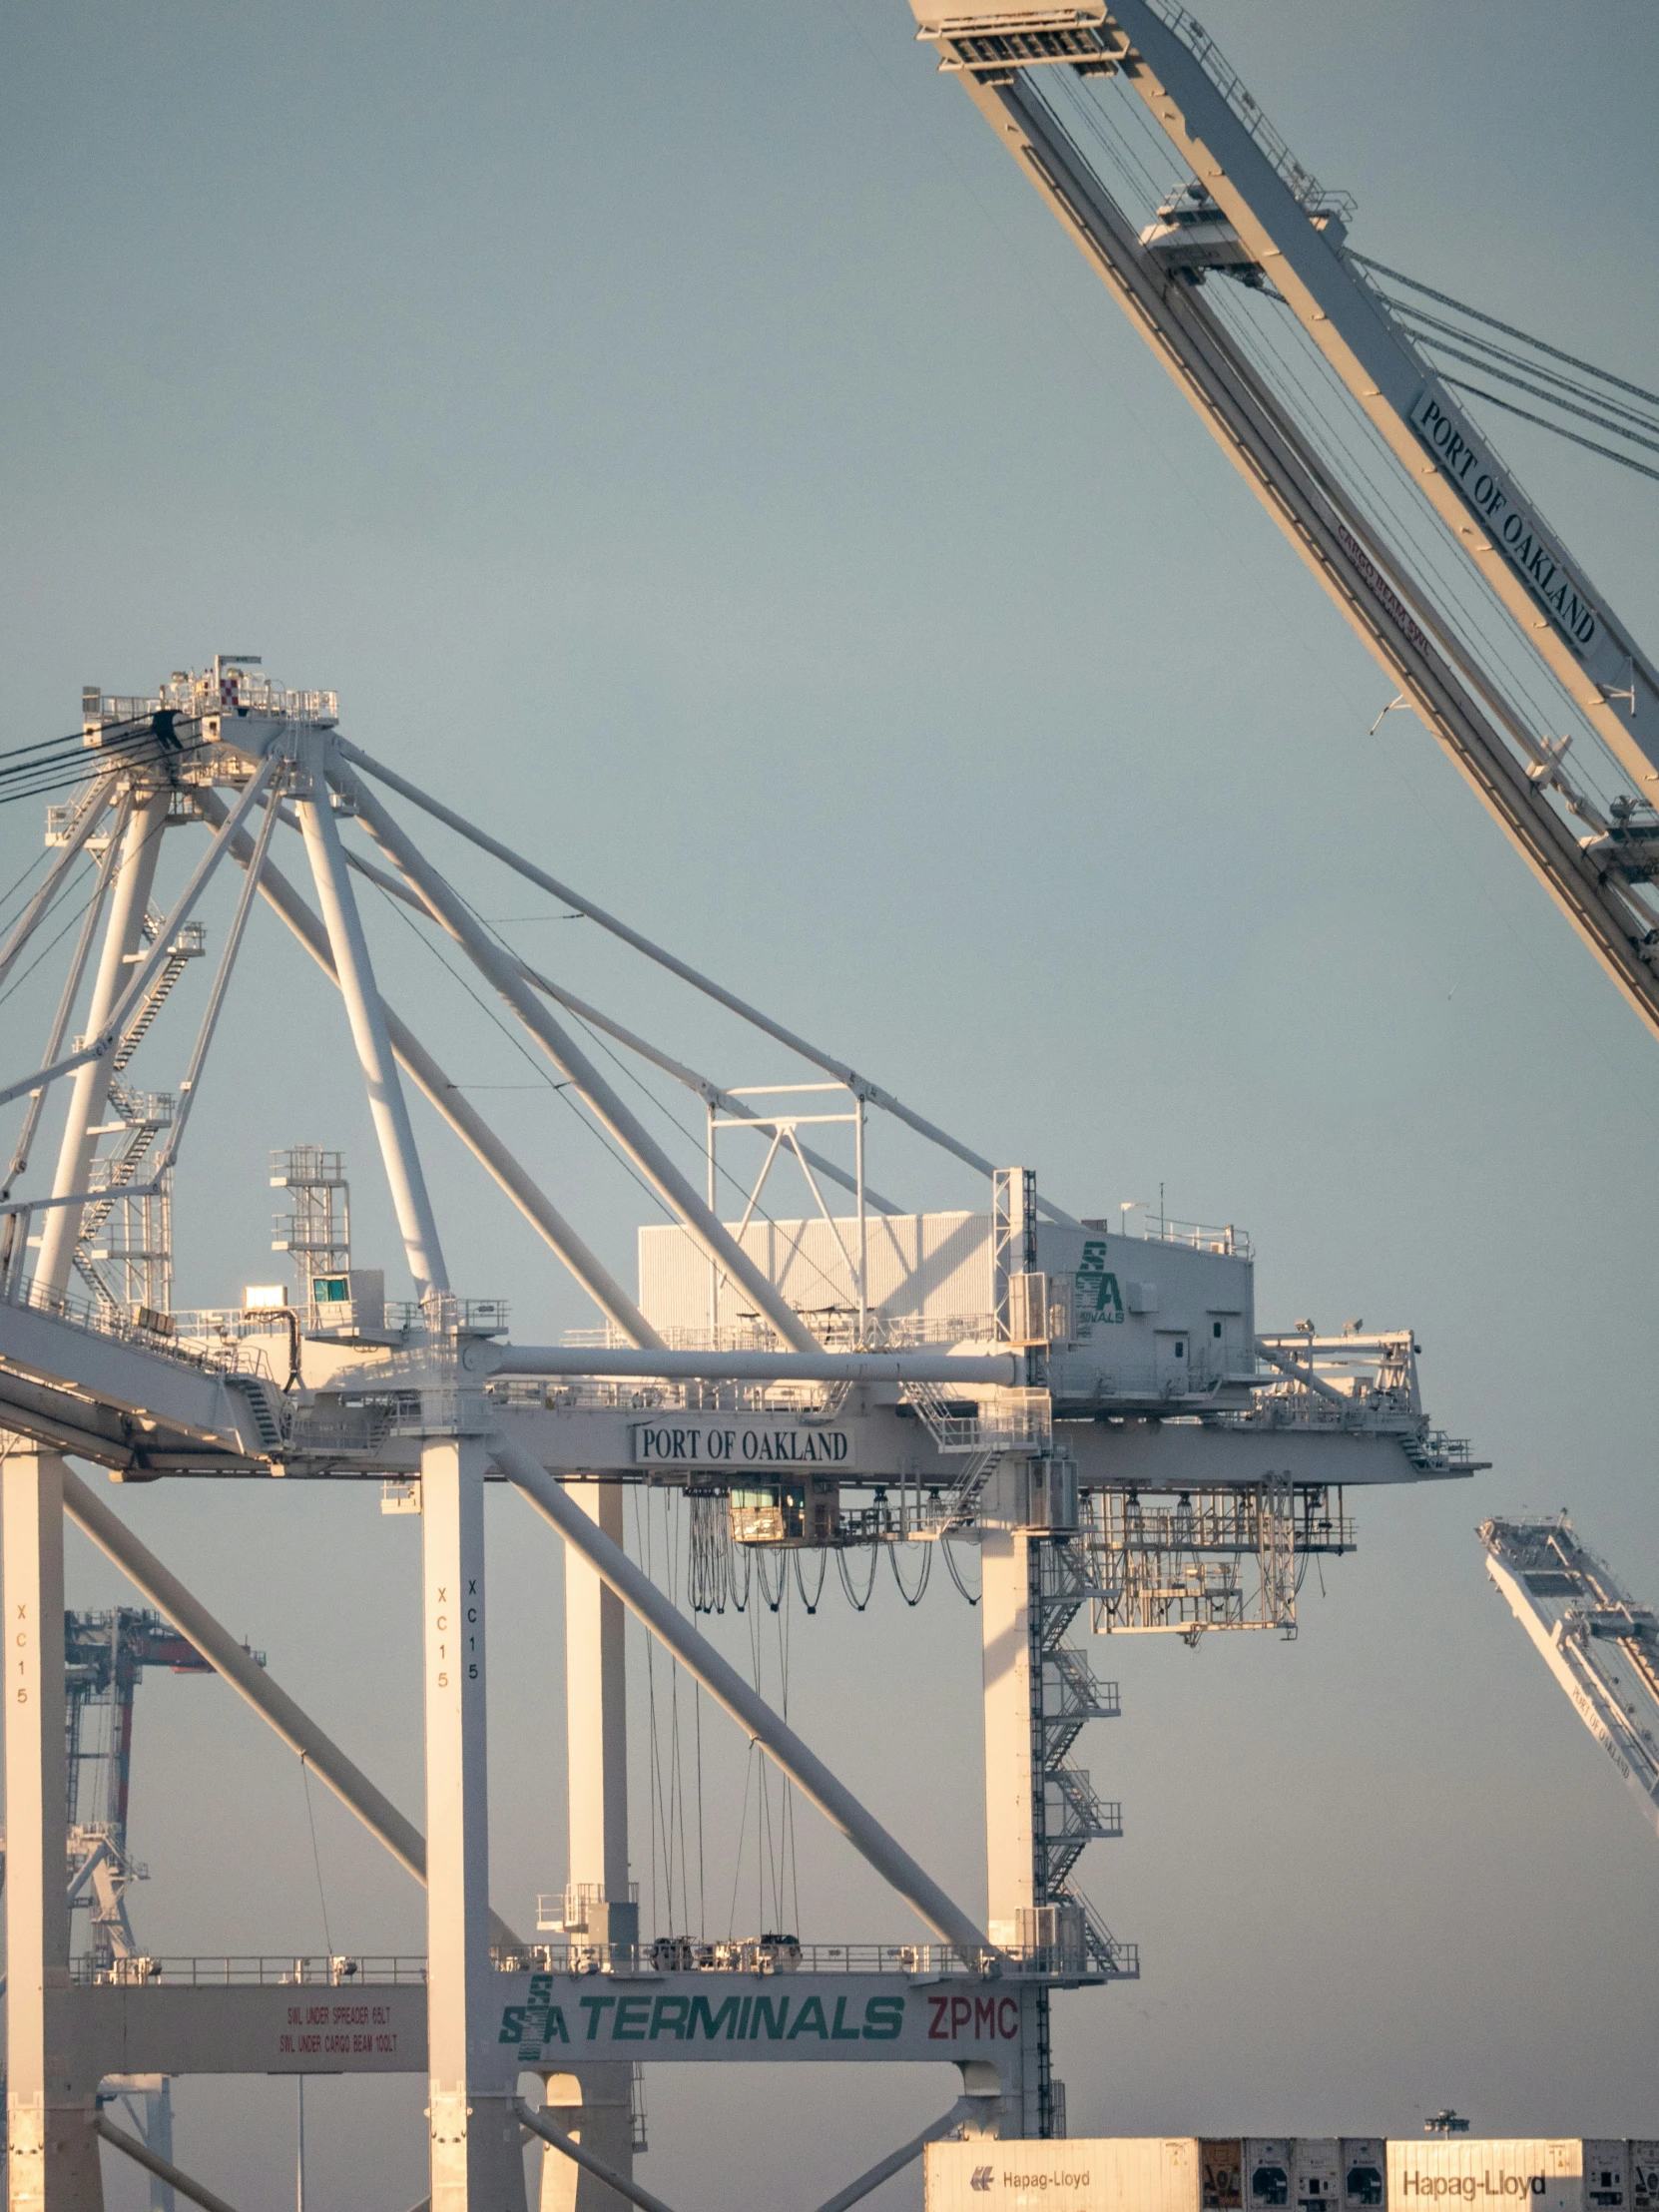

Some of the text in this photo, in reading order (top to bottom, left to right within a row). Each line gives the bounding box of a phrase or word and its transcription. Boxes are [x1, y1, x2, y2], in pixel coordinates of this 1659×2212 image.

[1420, 400, 1596, 644] PORT OF OAKLAND
[1338, 525, 1375, 579] CARGO
[643, 1428, 847, 1461] PORT OF OAKLAND
[287, 2006, 303, 2025] SWL
[306, 2006, 329, 2025] UNDER
[332, 2006, 369, 2025] SPREADER
[579, 1995, 905, 2040] TERMINALS
[927, 1996, 1020, 2040] ZPMC
[279, 2034, 295, 2052] SWL
[297, 2034, 321, 2052] UNDER
[325, 2034, 349, 2052] CARGO
[353, 2034, 372, 2052] BEAM
[1003, 2170, 1091, 2190] Hapag-Lloyd
[1402, 2169, 1546, 2201] Hapag-Lloyd
